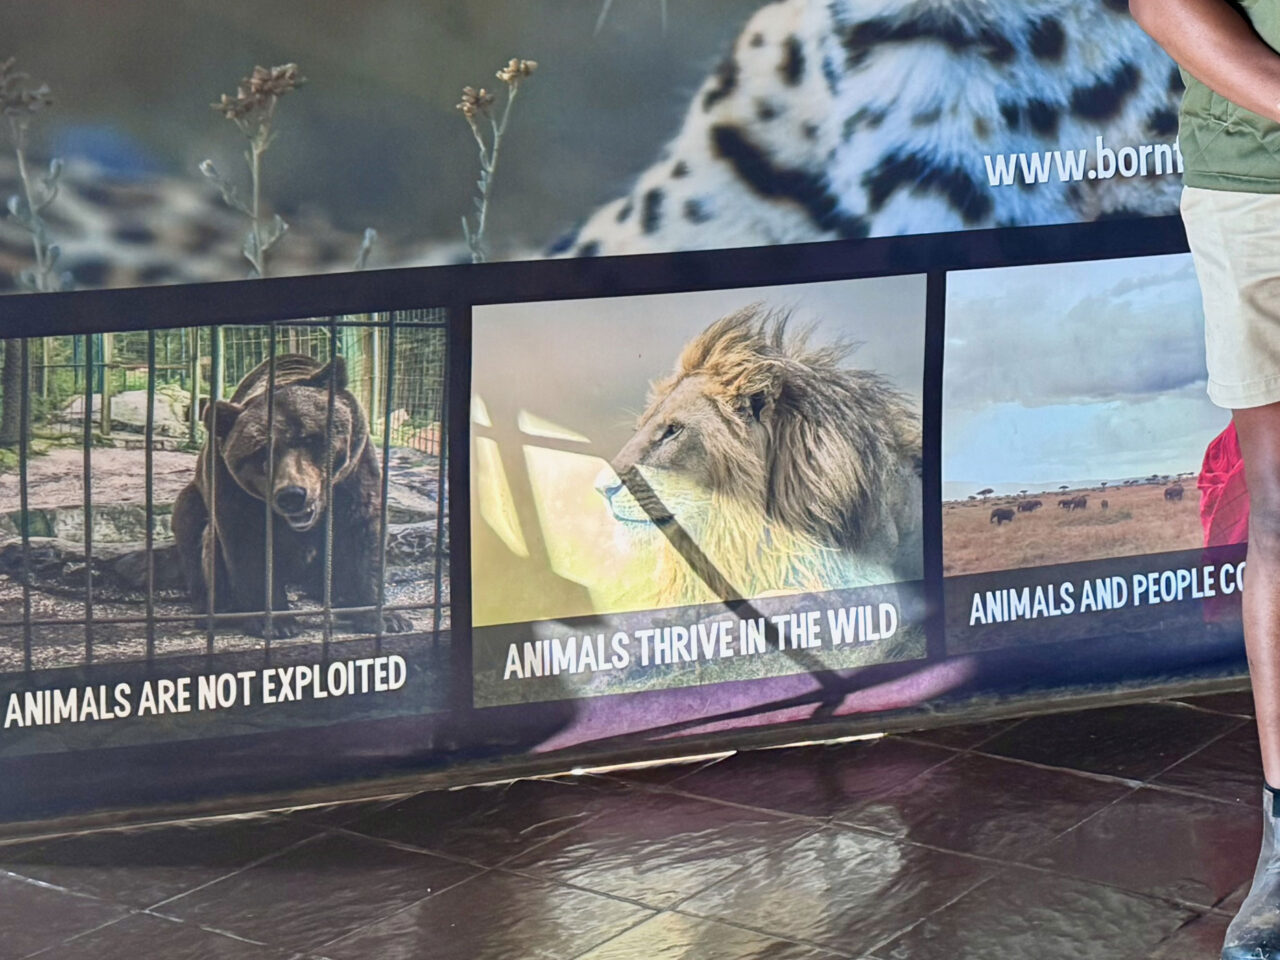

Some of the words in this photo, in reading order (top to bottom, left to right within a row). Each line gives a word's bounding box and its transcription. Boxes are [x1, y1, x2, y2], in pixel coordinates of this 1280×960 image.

[984, 135, 1184, 186] www.bornf
[969, 581, 1075, 626] ANIMALS
[1080, 576, 1128, 613] AND
[1132, 565, 1216, 606] PEOPLE
[503, 632, 629, 680] ANIMALS
[635, 620, 734, 666] THRIVE
[739, 617, 766, 655] IN
[772, 610, 821, 651] THE
[826, 603, 898, 643] WILD
[4, 683, 131, 728] ANIMALS
[138, 677, 191, 716] ARE
[198, 671, 256, 711] NOT
[262, 655, 407, 704] EXPLOITED
